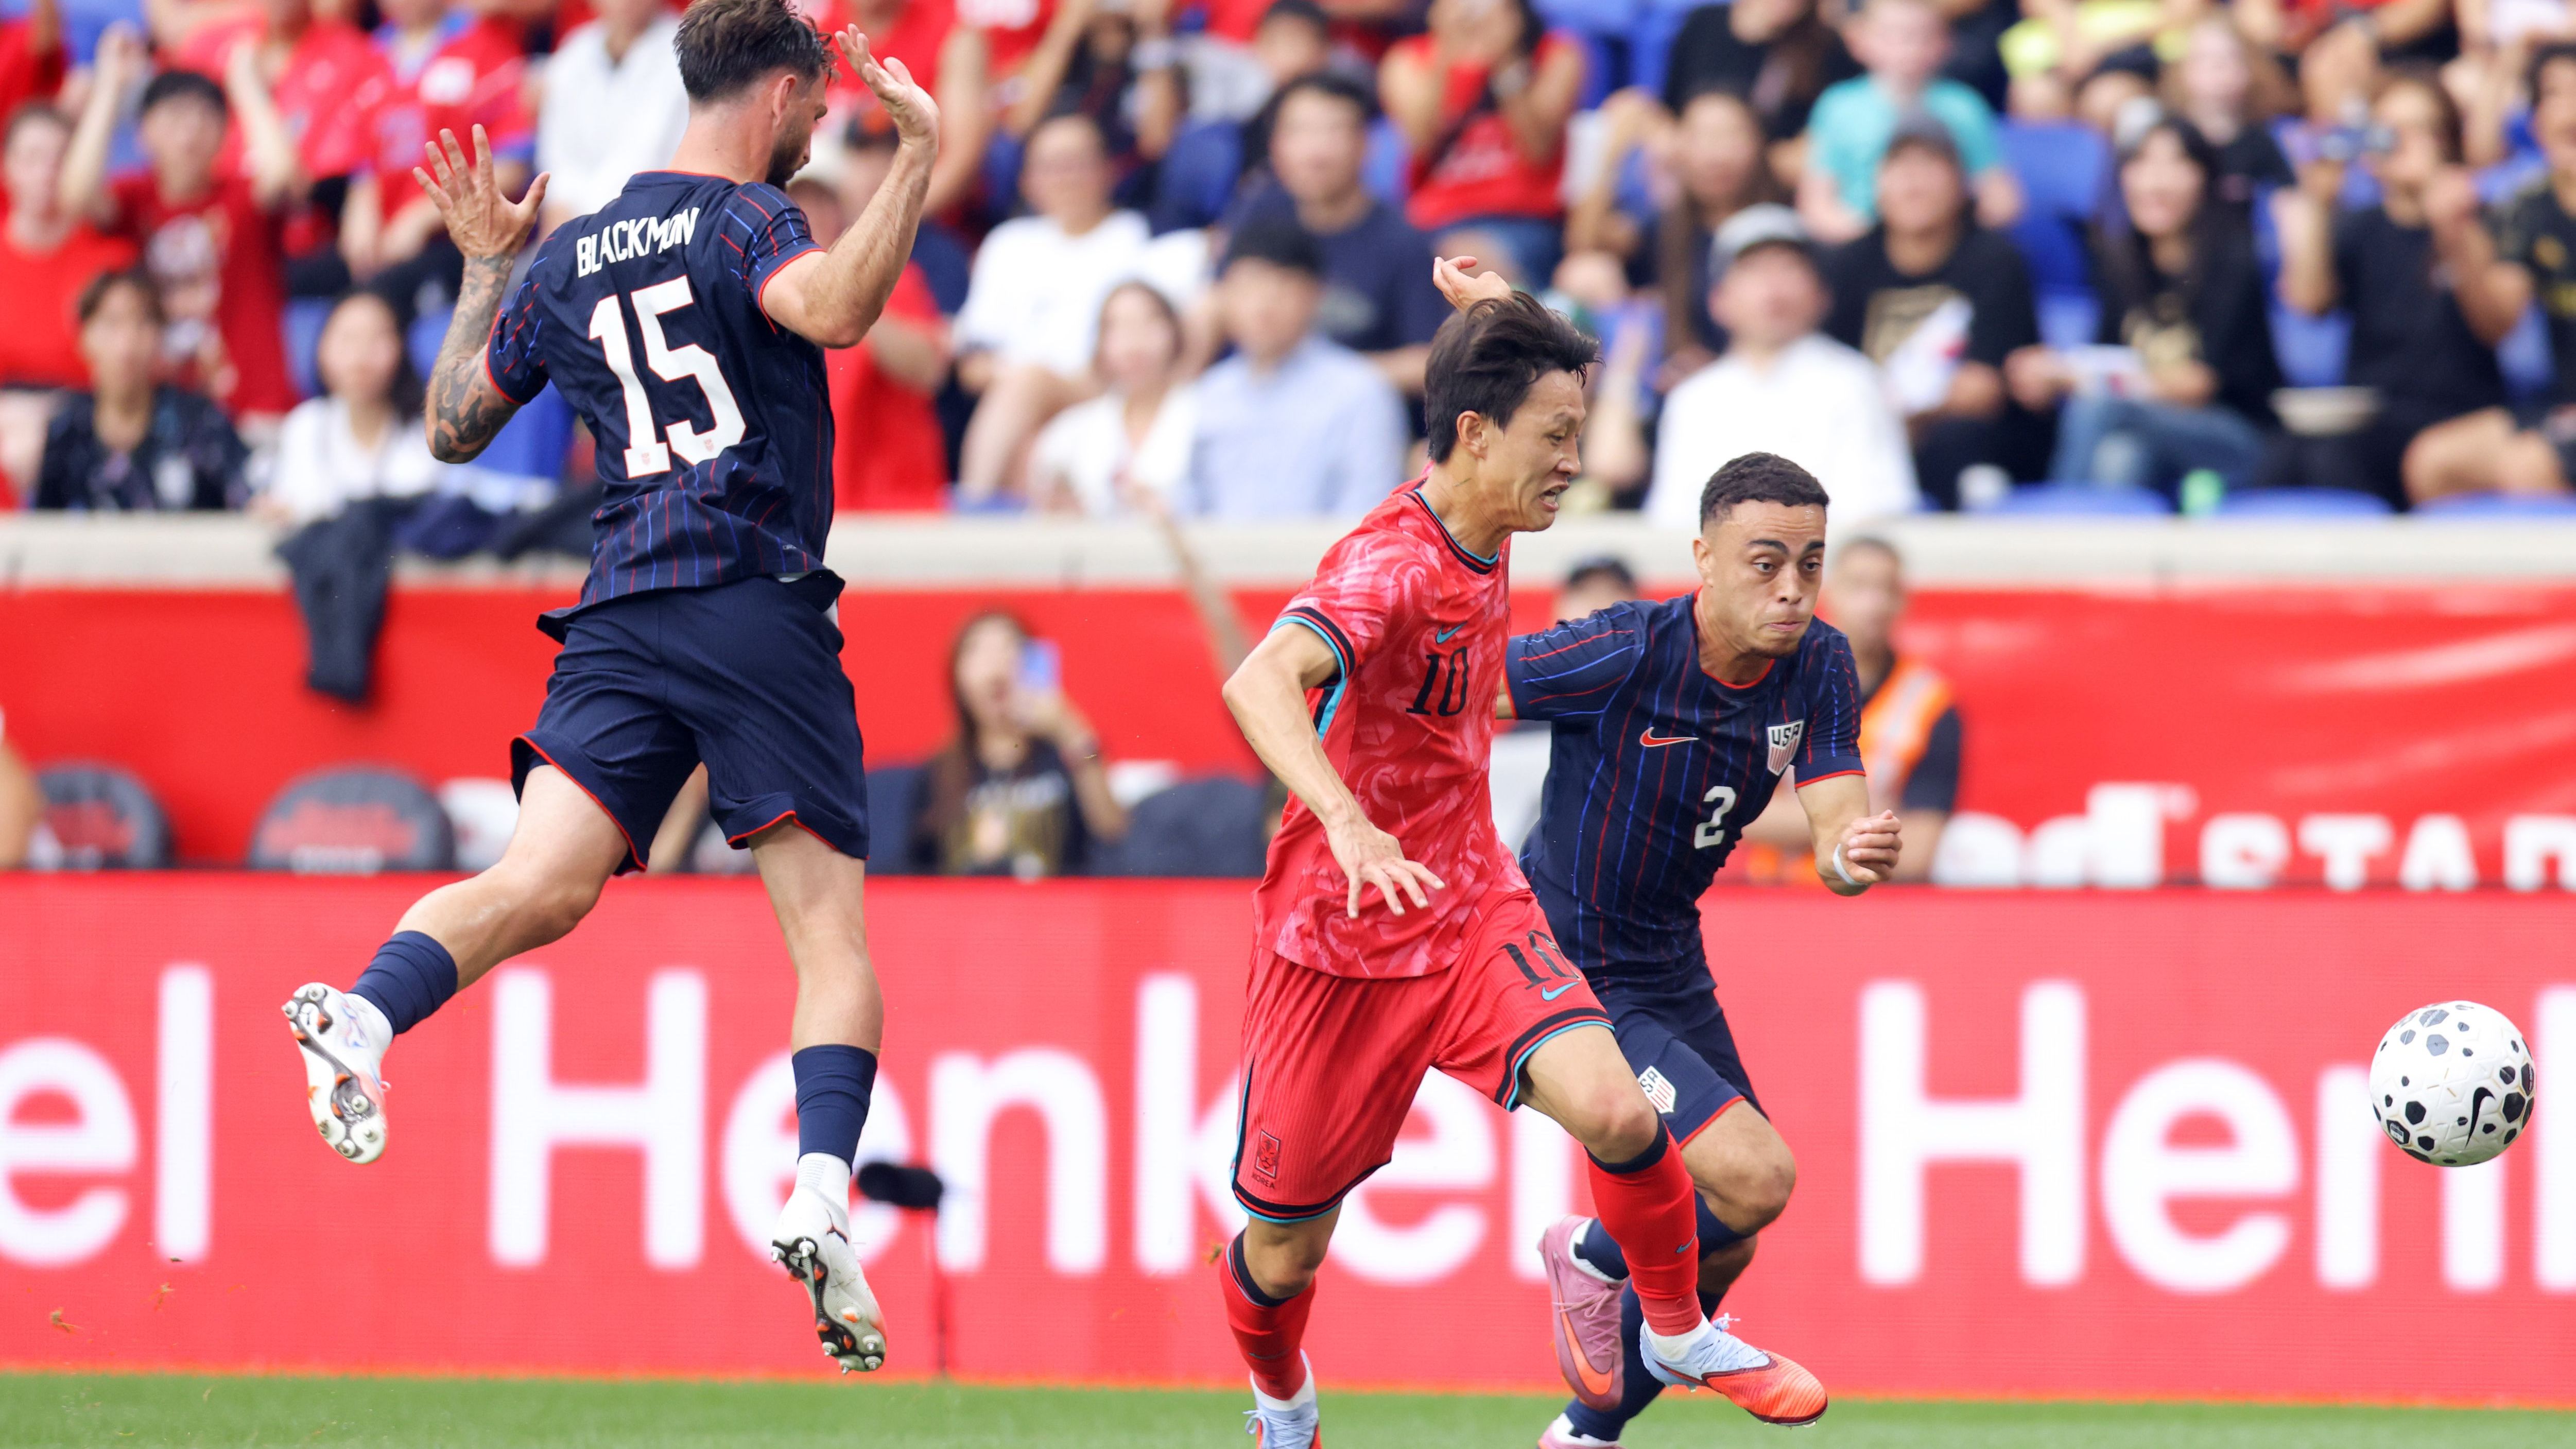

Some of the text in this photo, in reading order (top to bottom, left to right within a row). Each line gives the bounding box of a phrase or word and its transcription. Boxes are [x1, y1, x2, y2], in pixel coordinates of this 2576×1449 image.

[577, 207, 700, 278] BLACKMON
[589, 275, 747, 479] 15
[1406, 646, 1468, 716] 10
[1771, 723, 1801, 747] USA
[1694, 785, 1737, 850] 2
[1496, 929, 1582, 990] 10
[1639, 1070, 1658, 1093] SA
[1858, 978, 2576, 1293] Hen
[1252, 1174, 1275, 1189] KOREA
